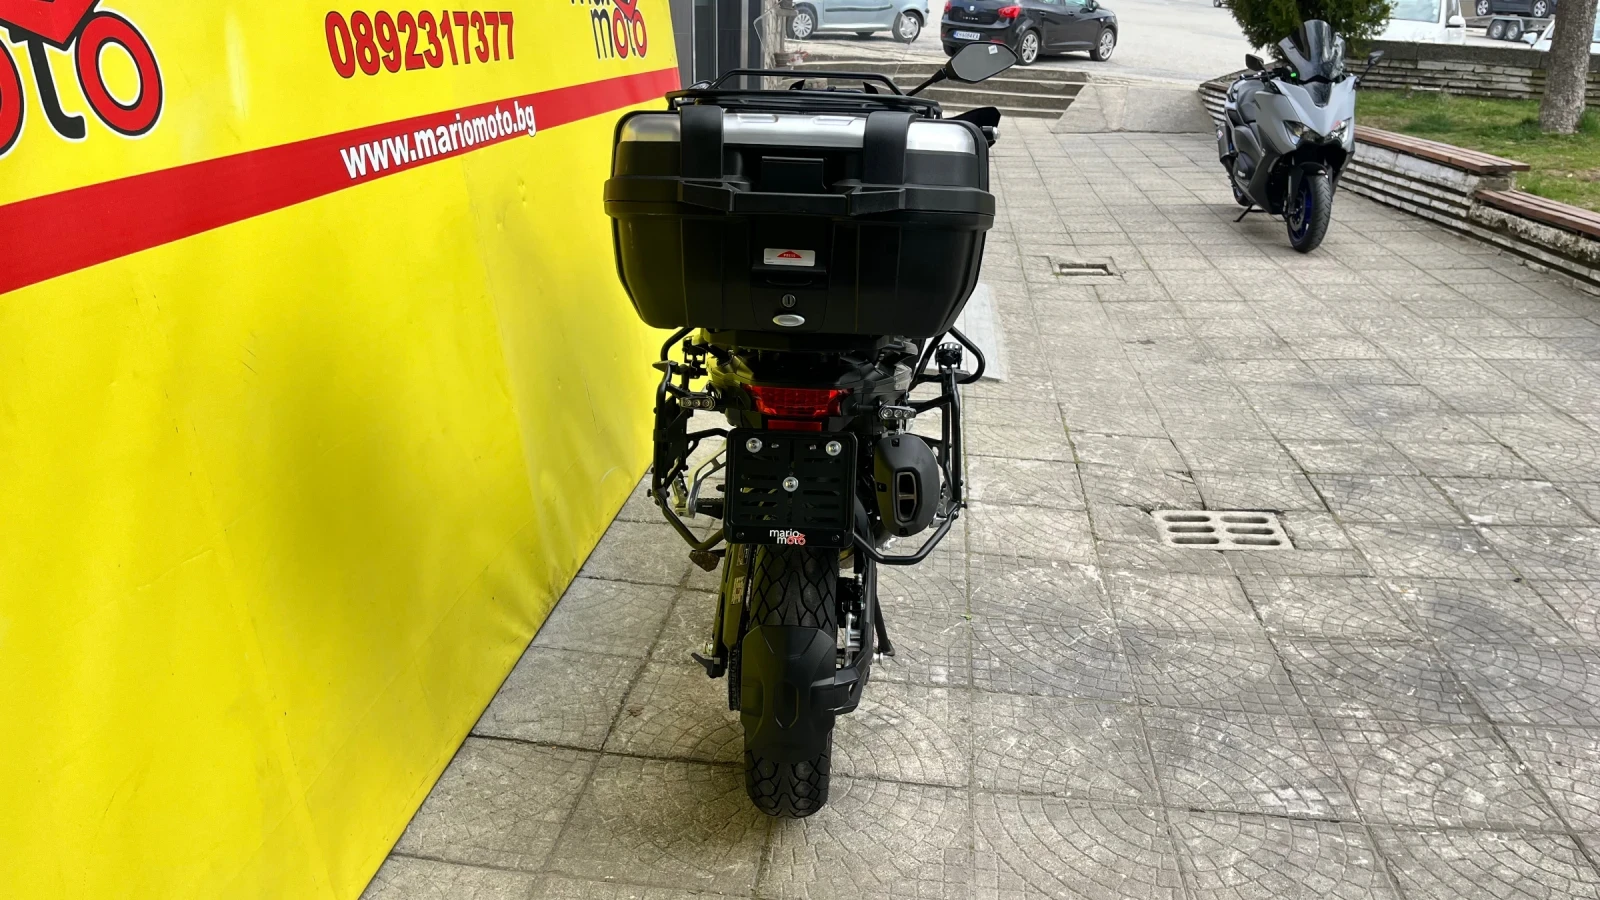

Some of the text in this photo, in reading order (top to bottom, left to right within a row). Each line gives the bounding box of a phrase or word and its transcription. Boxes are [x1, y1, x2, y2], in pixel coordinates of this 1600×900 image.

[325, 10, 514, 79] 0892317377
[590, 8, 647, 59] moto
[340, 100, 536, 179] www.mariomoto.bg
[769, 528, 800, 538] mario
[776, 536, 806, 546] moto
